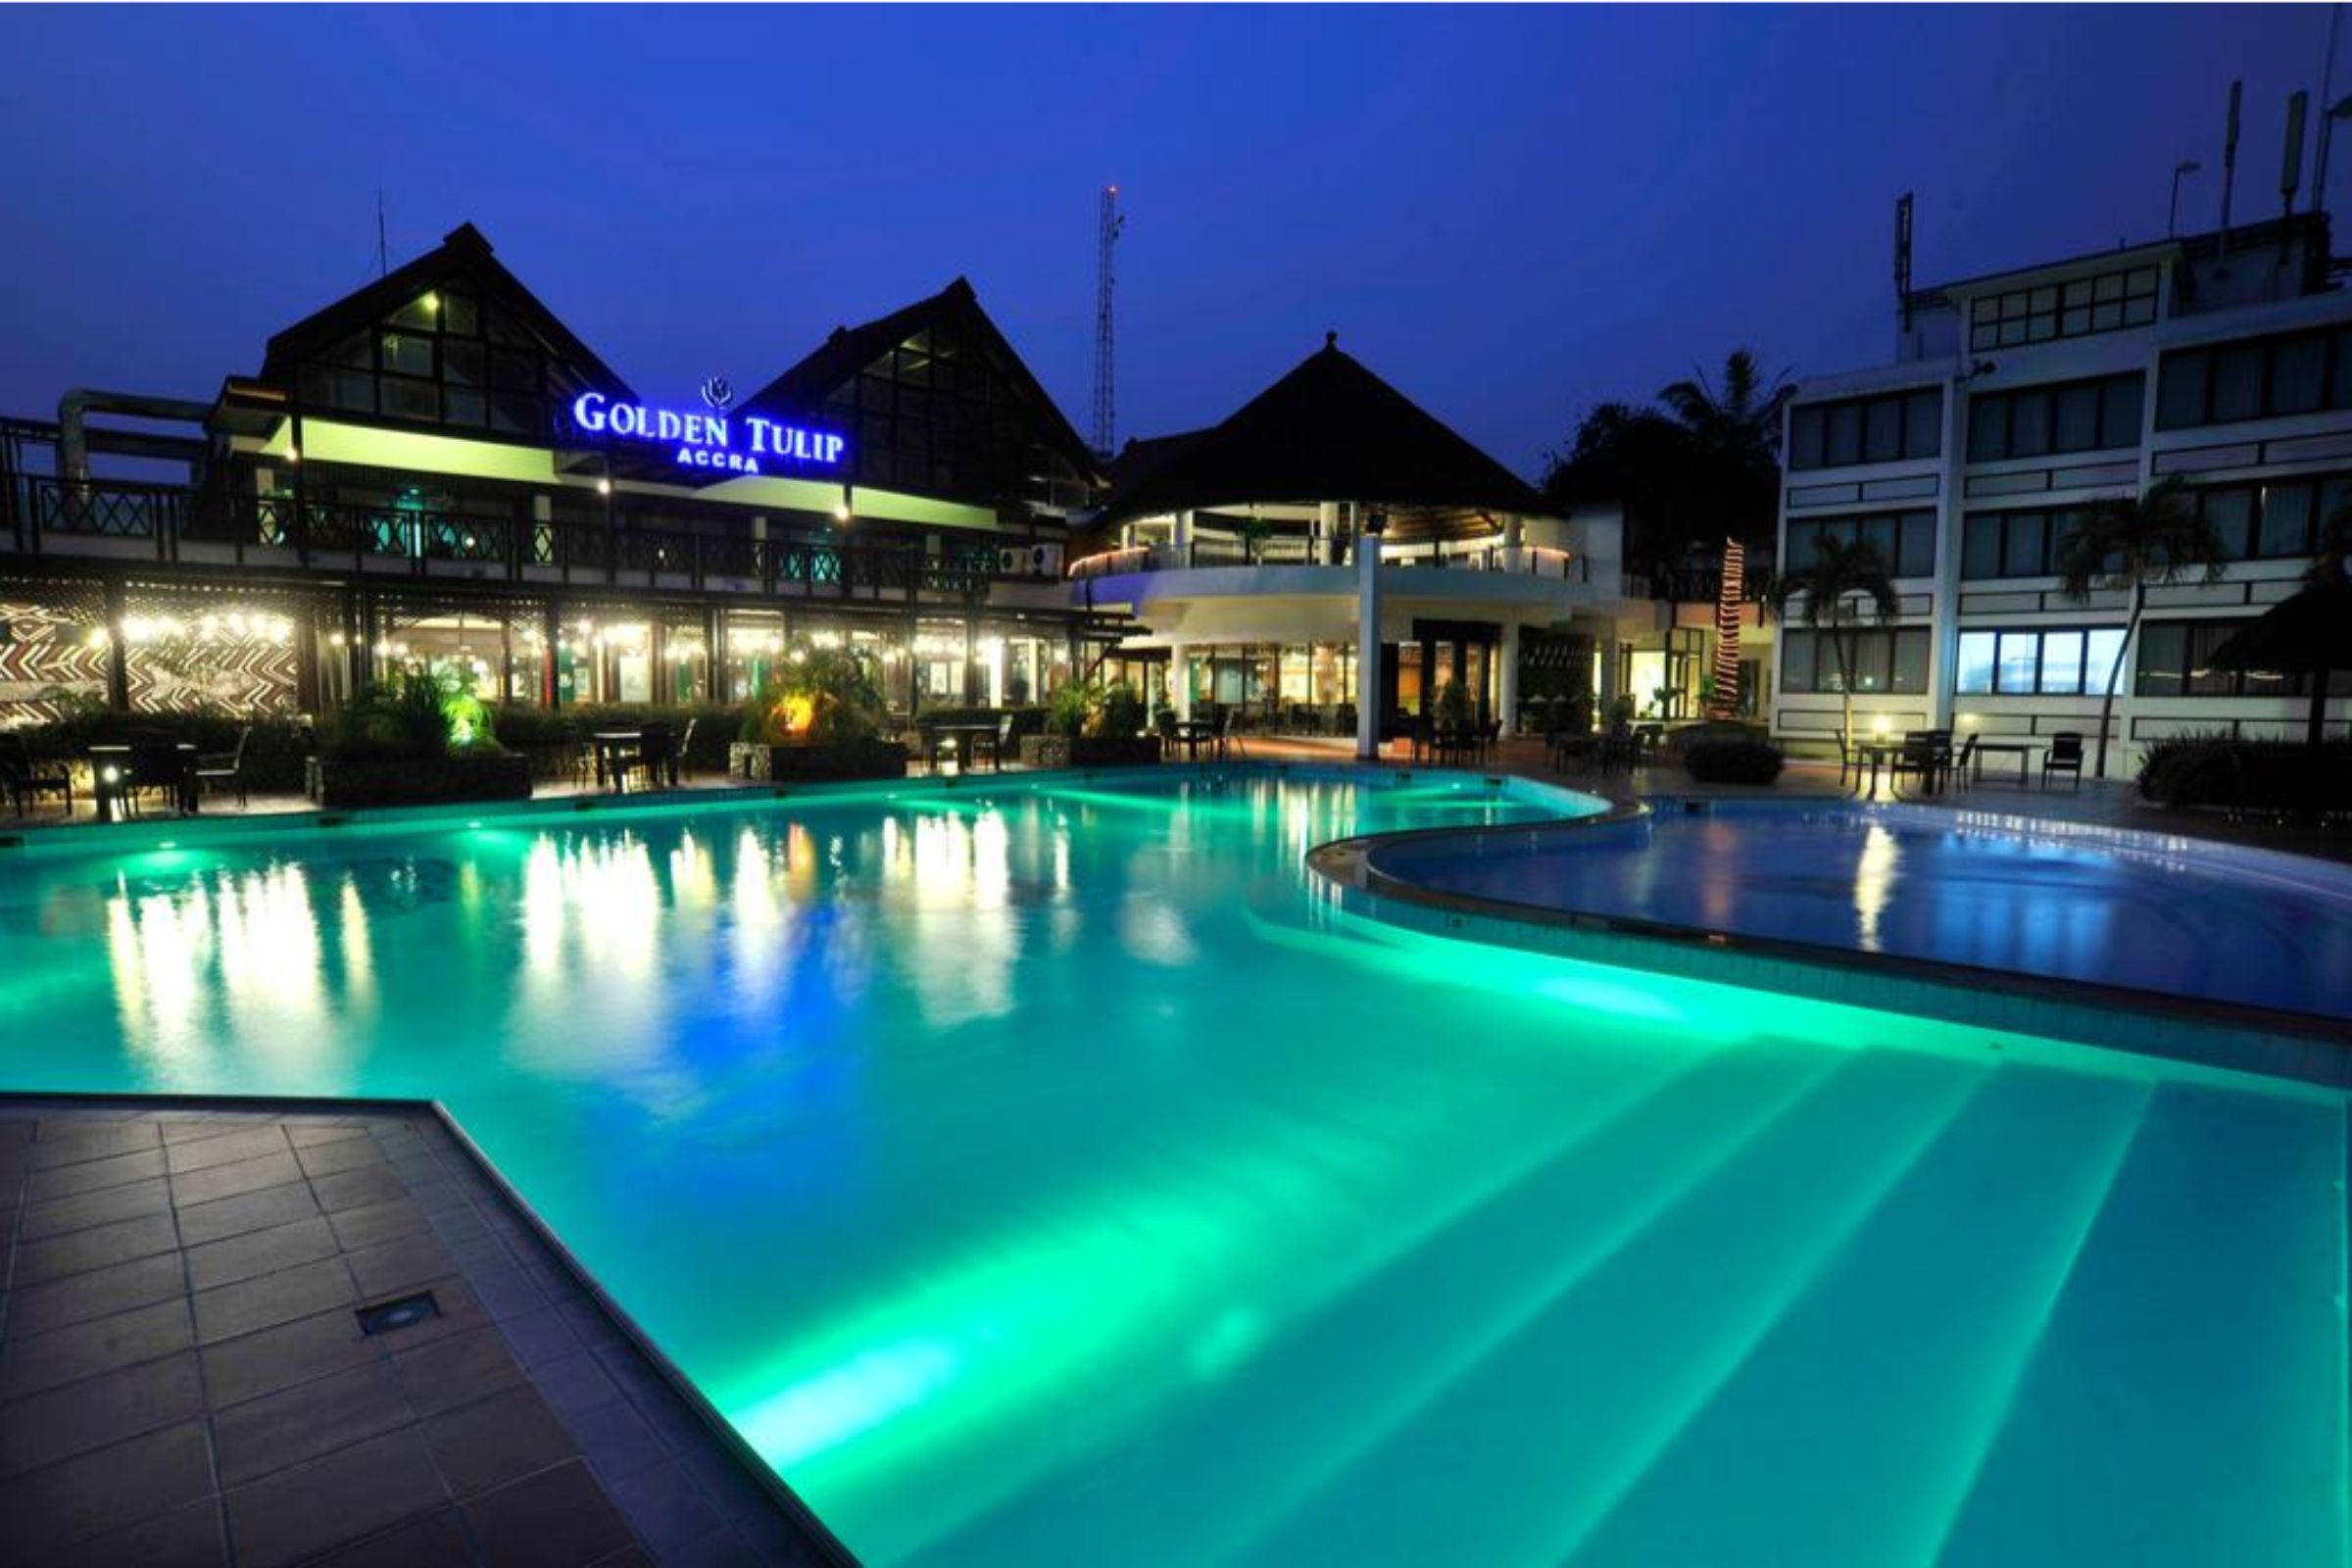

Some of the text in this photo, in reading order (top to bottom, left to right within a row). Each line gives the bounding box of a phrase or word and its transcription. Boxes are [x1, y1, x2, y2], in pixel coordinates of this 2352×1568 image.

[573, 392, 844, 463] GOLDEN TULIP
[677, 448, 759, 473] ACCRA
